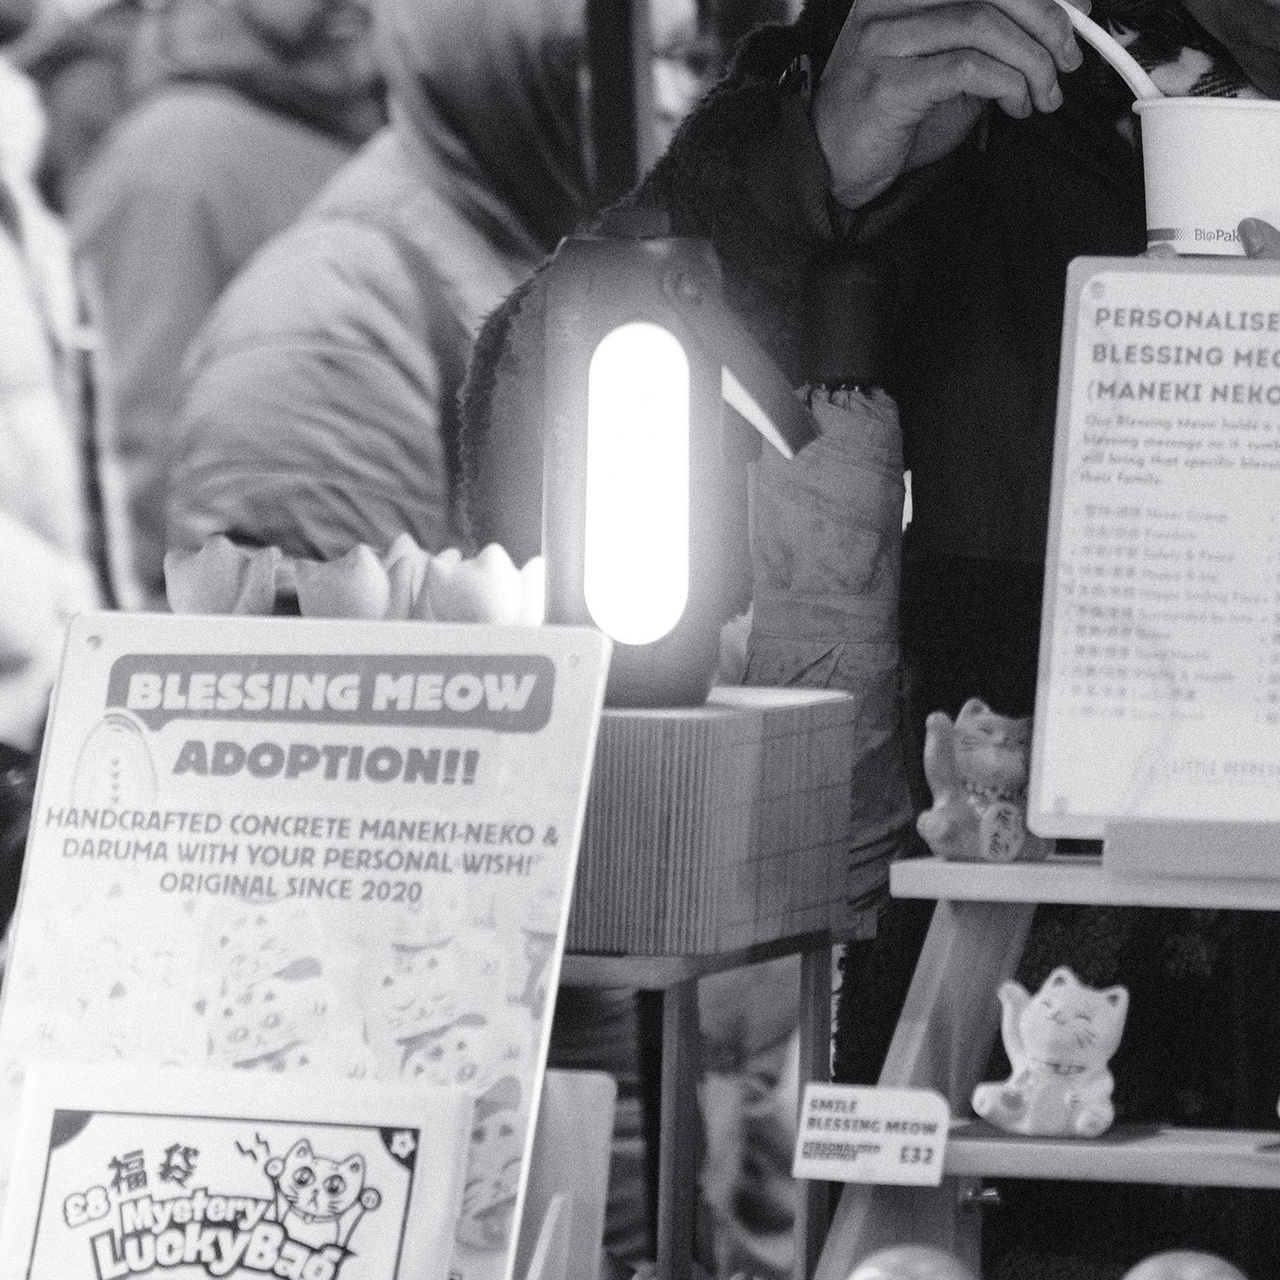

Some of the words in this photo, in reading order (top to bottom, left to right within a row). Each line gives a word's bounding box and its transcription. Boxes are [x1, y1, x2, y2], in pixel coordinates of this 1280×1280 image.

[1095, 307, 1280, 332] PERSONALISE
[1092, 343, 1223, 366] BLESSING
[1088, 380, 1202, 403] (MANEKI
[126, 672, 361, 711] BLESSING
[371, 674, 538, 713] MEOW
[171, 740, 480, 786] ADOPTION!!
[45, 807, 223, 833] HANDCRAFTED
[229, 813, 351, 839] CONCRETE
[359, 818, 535, 846] MANEKI-NEKO
[542, 825, 559, 847] &
[61, 838, 168, 862] DARUMA
[177, 841, 239, 865] WITH
[247, 844, 316, 868] YOUR
[323, 847, 453, 873] PERSONAL
[461, 851, 533, 877] WISH!
[160, 872, 278, 899] ORIGINAL
[285, 876, 352, 900] SINCE
[360, 879, 423, 904] 2020
[806, 1116, 882, 1133] BLESSING
[885, 1120, 938, 1136] MEOW
[120, 1187, 272, 1236] Mystery
